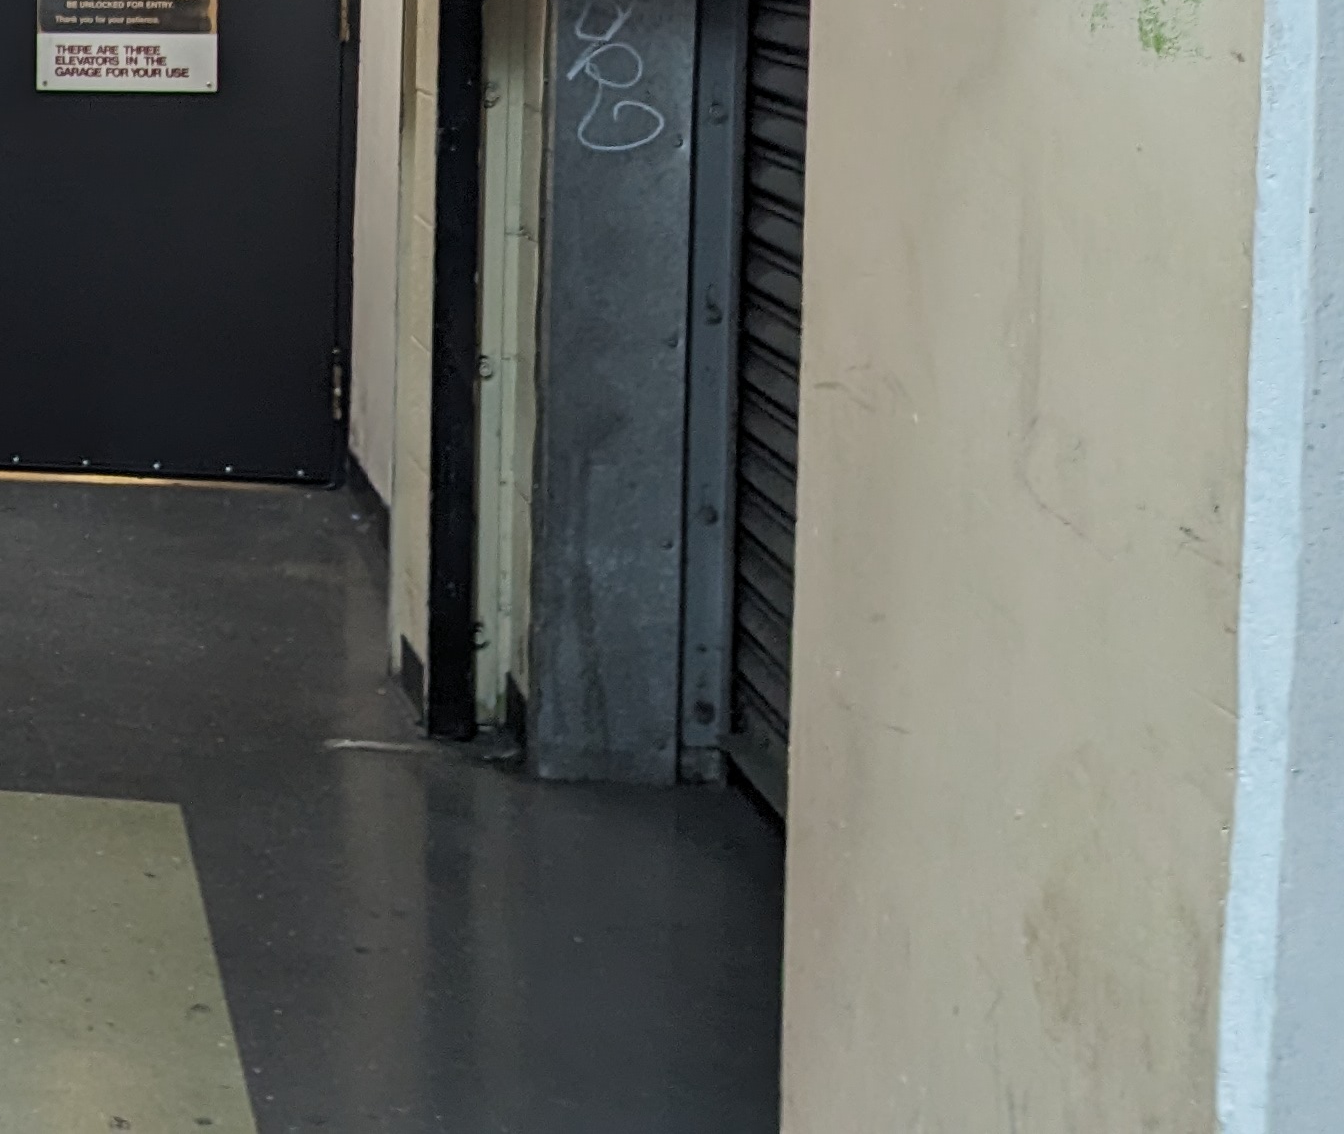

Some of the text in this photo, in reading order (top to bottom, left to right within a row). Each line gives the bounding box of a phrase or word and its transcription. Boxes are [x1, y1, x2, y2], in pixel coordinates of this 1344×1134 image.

[80, 17, 93, 25] you
[55, 45, 160, 55] THERE ARE THREE
[55, 56, 167, 66] ELEVATORS IN THE
[55, 67, 189, 78] GARAGE FOR YOUR USE
